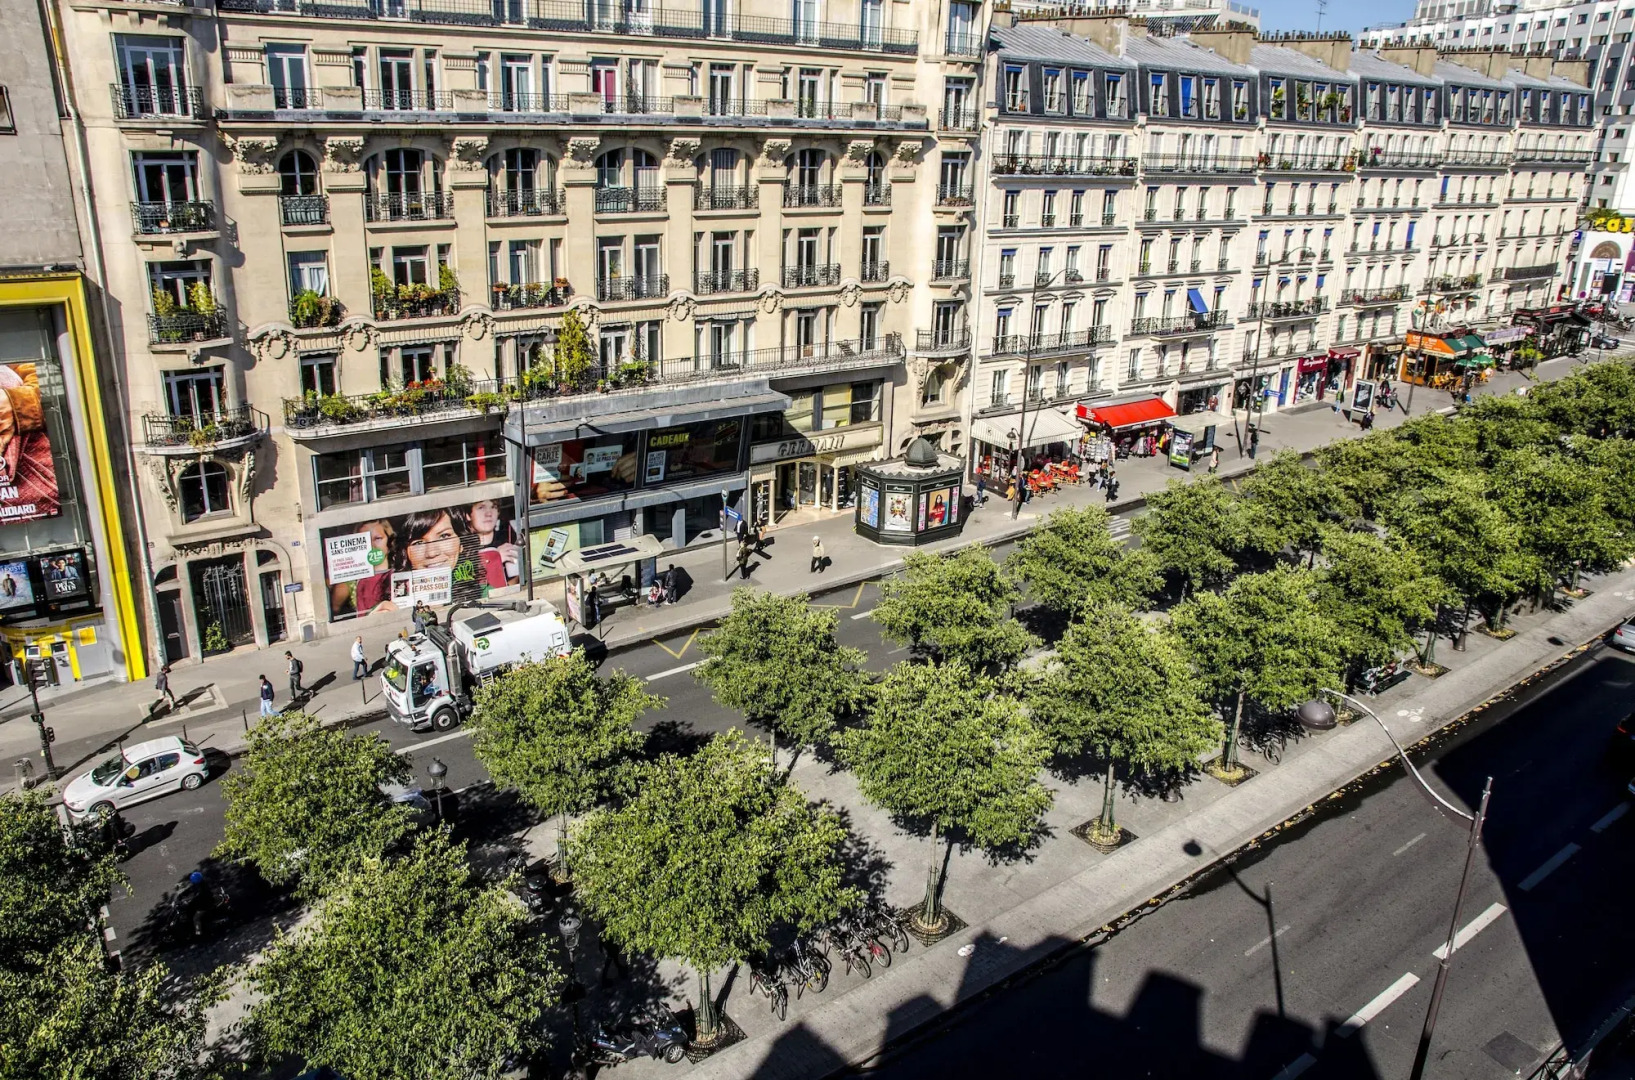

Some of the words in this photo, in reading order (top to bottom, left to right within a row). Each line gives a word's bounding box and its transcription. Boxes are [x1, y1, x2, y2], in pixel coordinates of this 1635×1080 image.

[650, 432, 690, 447] CADEAUX
[537, 450, 560, 461] CARTE
[330, 541, 338, 550] LE
[340, 536, 367, 548] CINEMA
[345, 545, 368, 553] COMPTER
[420, 583, 433, 591] PASS
[435, 582, 448, 590] SOLO
